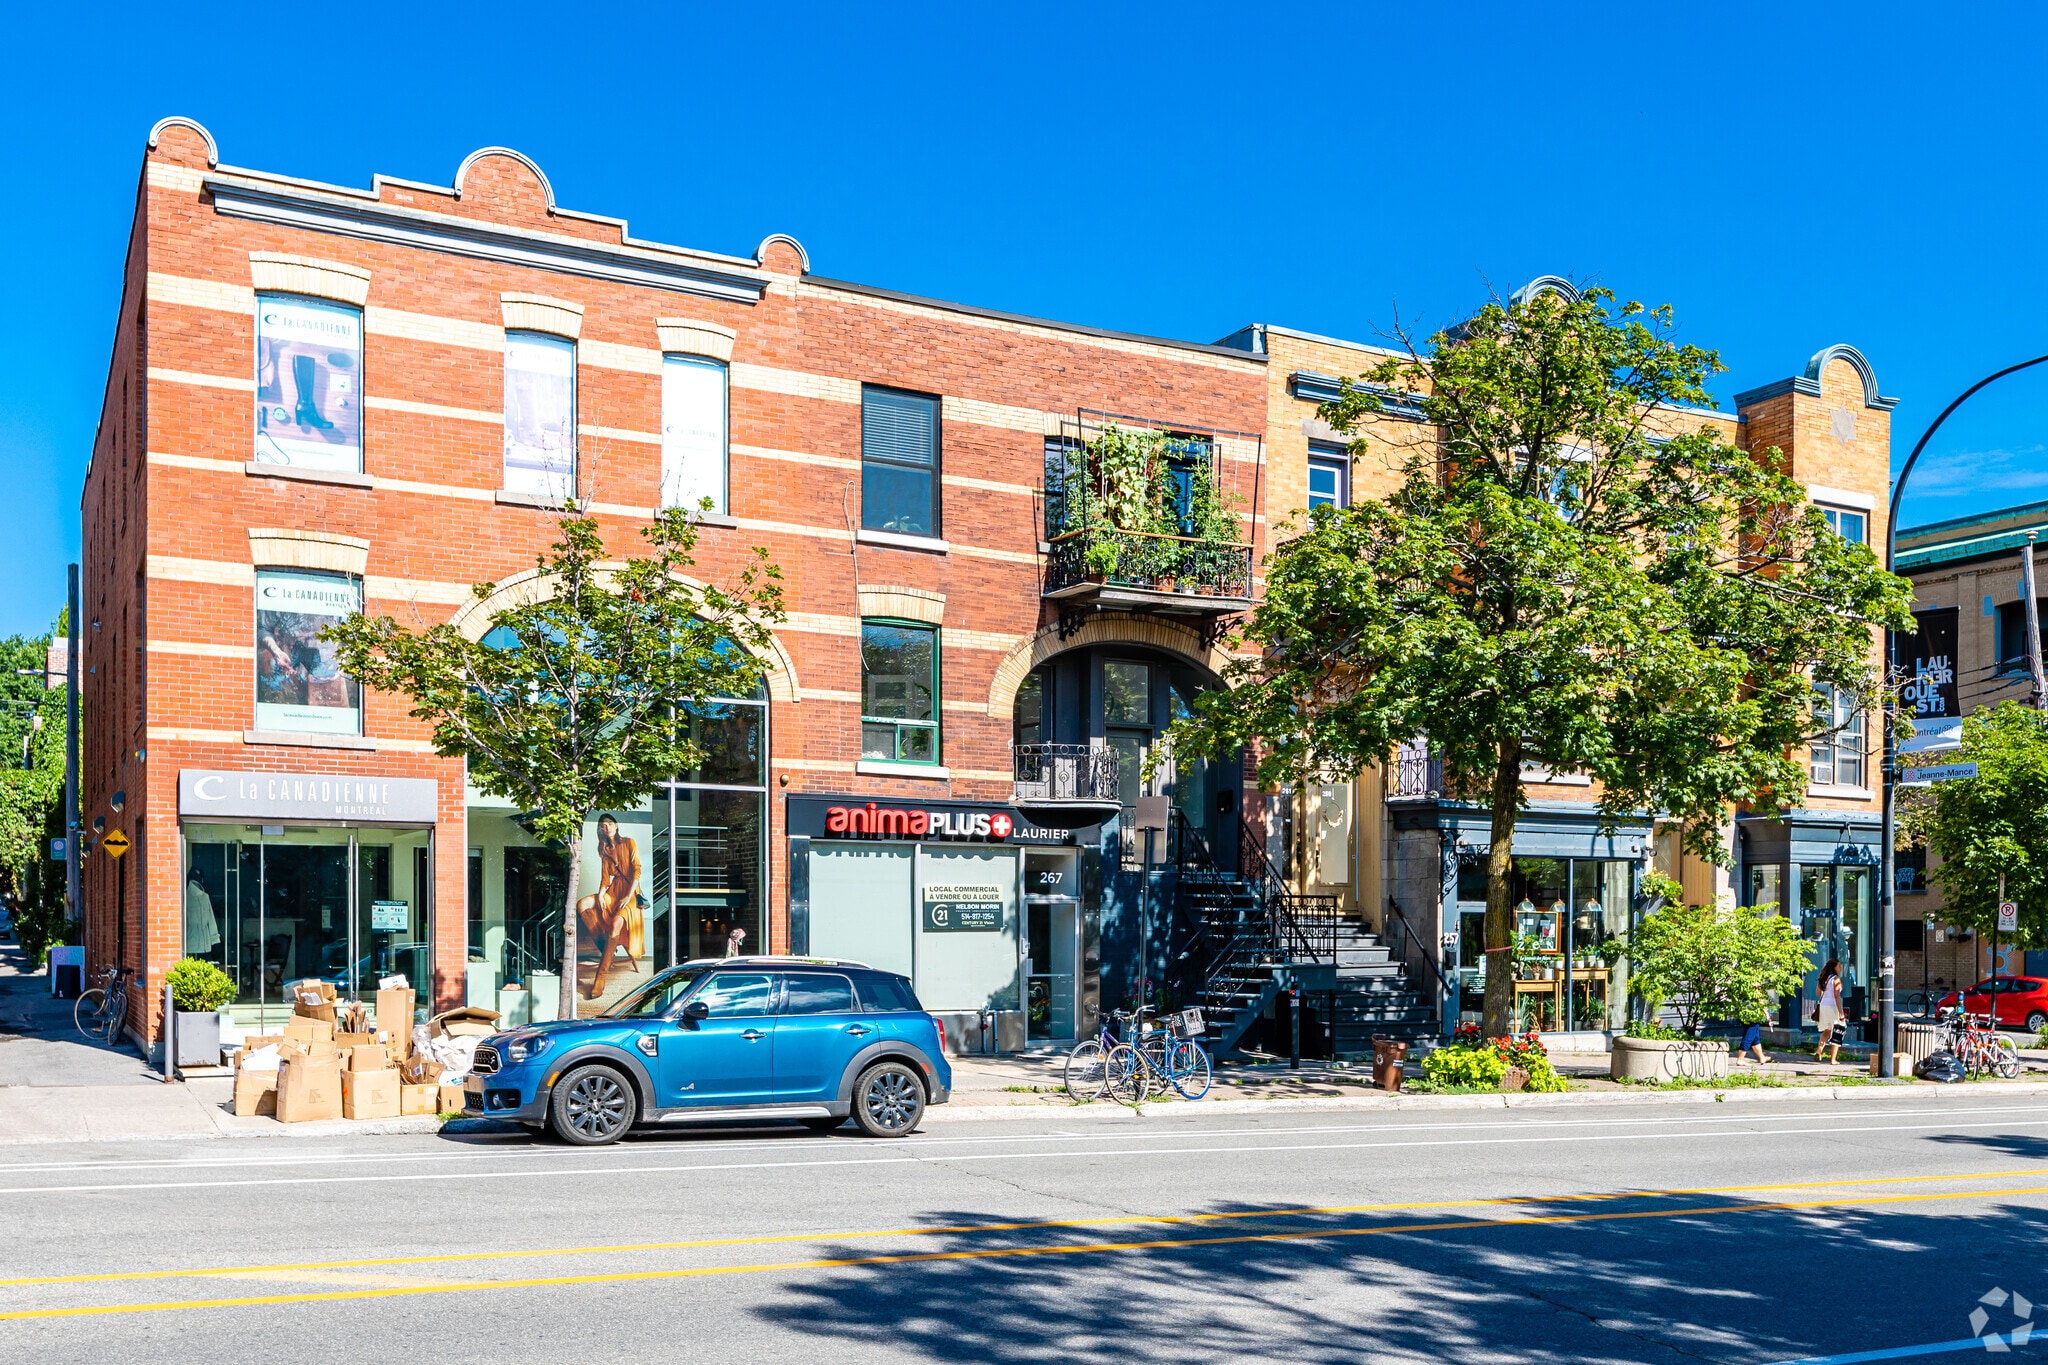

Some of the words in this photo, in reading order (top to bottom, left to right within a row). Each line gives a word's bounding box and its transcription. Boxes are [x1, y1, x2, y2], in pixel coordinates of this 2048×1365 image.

[296, 319, 351, 335] CANADIENNE
[1904, 684, 1940, 701] OUE
[1917, 769, 1973, 780] Jeanne-Mance
[268, 779, 389, 805] CANADIENNE
[1013, 827, 1069, 840] LAURIER
[1040, 872, 1063, 884] 267
[1444, 933, 1458, 944] 257
